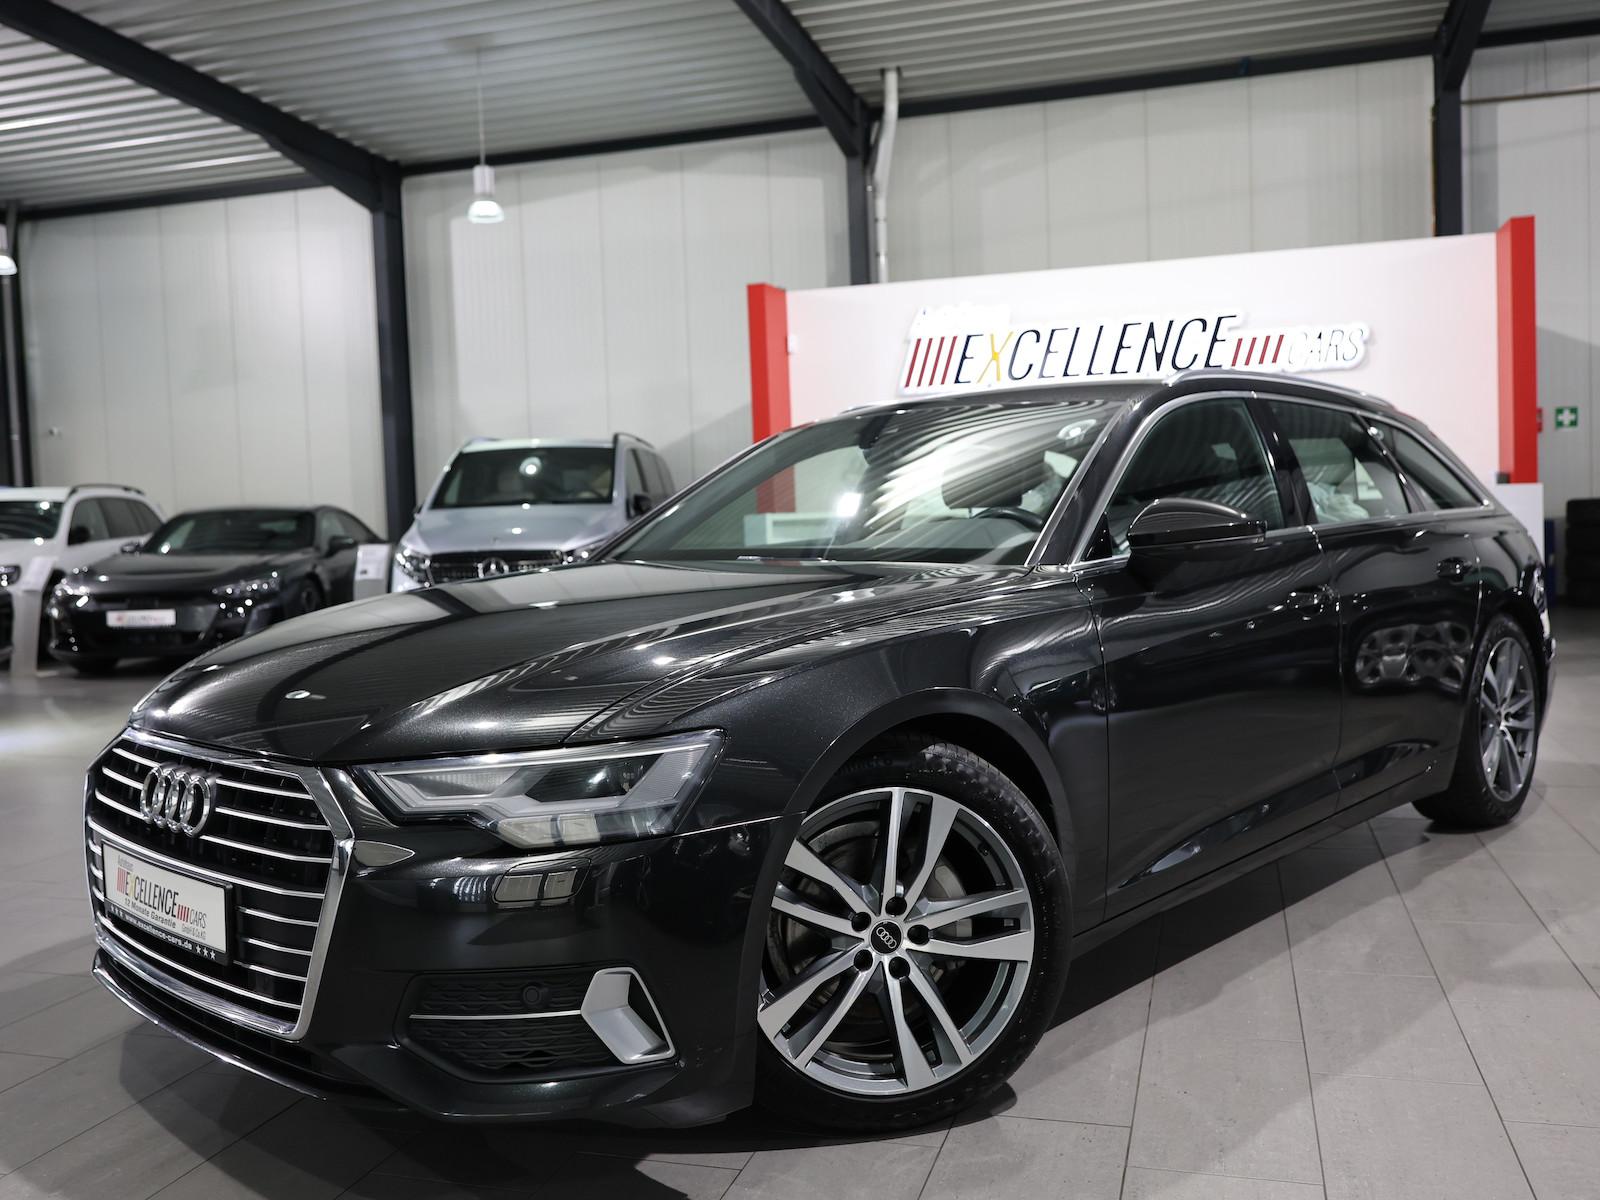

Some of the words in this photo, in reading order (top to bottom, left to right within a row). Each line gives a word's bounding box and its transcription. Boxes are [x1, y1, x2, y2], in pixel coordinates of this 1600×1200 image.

[953, 314, 1238, 385] EXCELLENCE
[1287, 327, 1364, 365] CARS
[125, 871, 179, 918] EXCELLENCE
[189, 908, 207, 929] CARS
